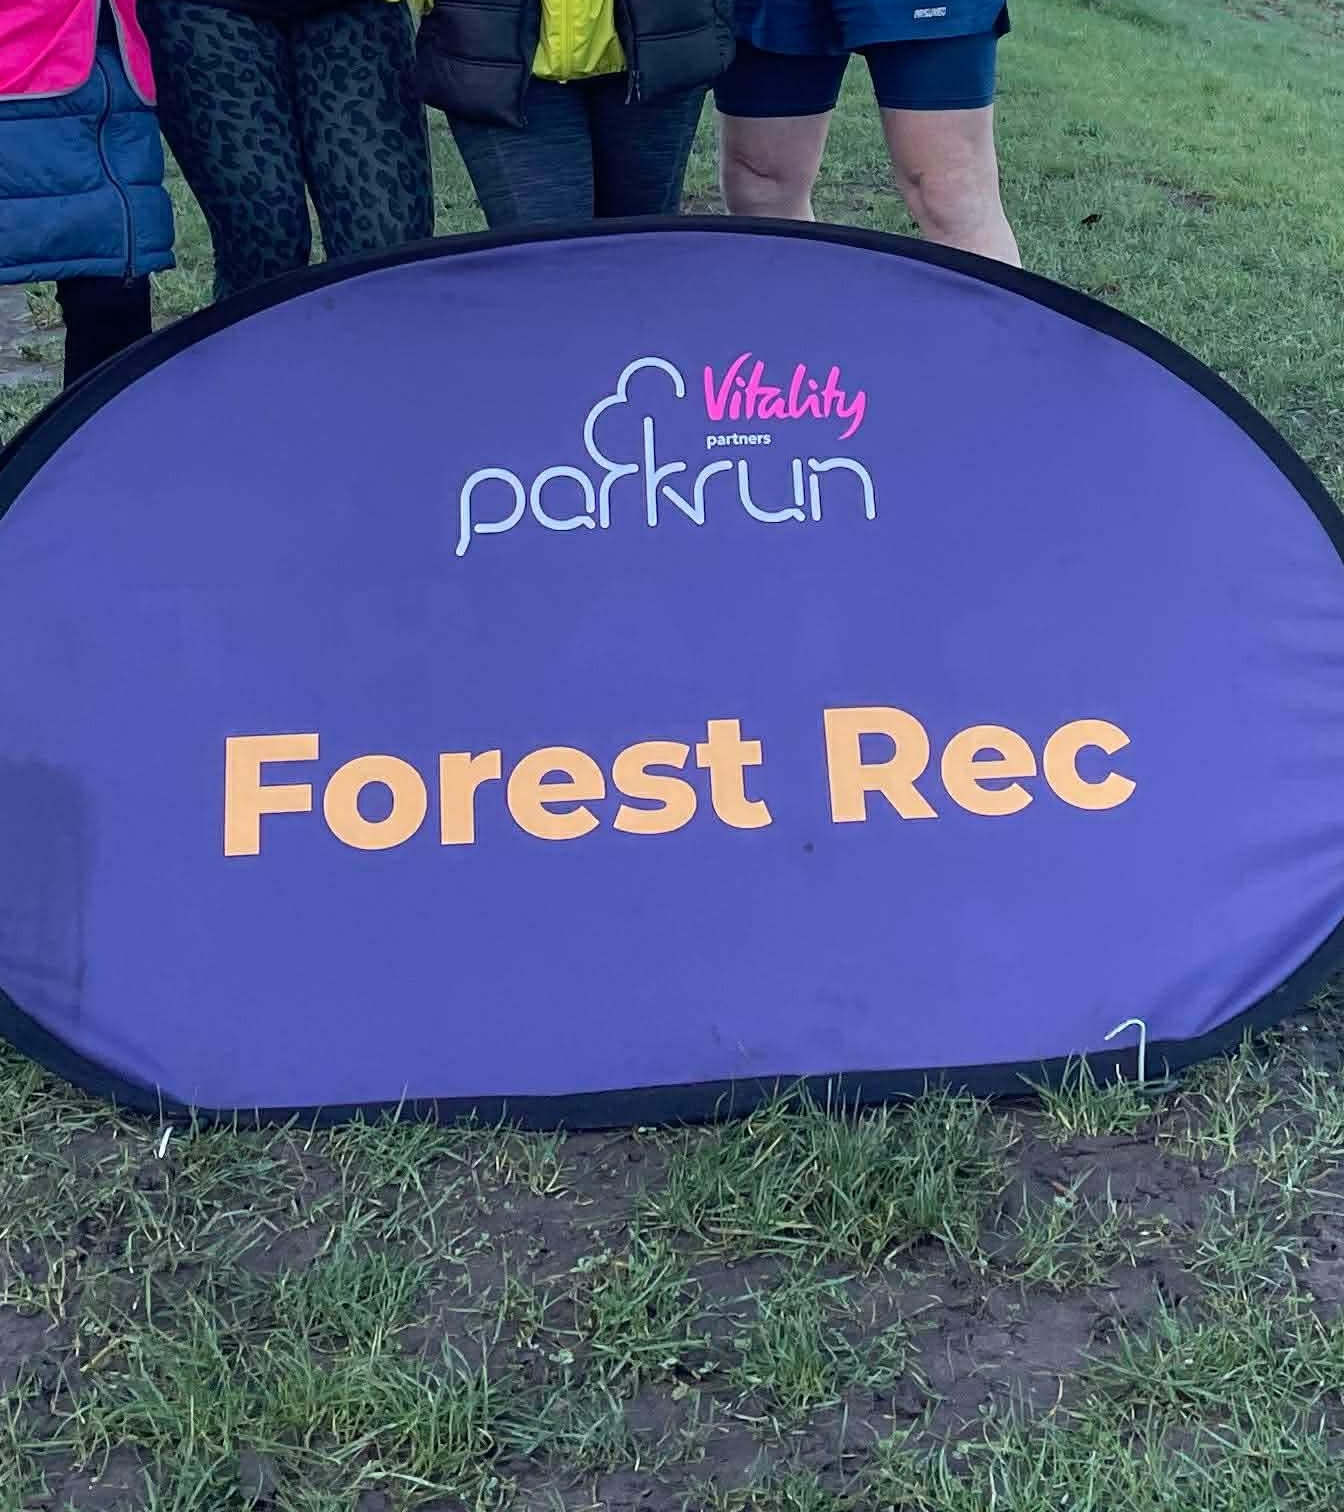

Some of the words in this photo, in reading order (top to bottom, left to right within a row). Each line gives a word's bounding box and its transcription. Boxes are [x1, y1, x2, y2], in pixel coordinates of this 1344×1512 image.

[703, 352, 867, 441] Vitality
[706, 432, 772, 449] partners
[456, 357, 876, 557] parkrun
[224, 719, 772, 856] Forest
[823, 706, 1137, 823] Rec
